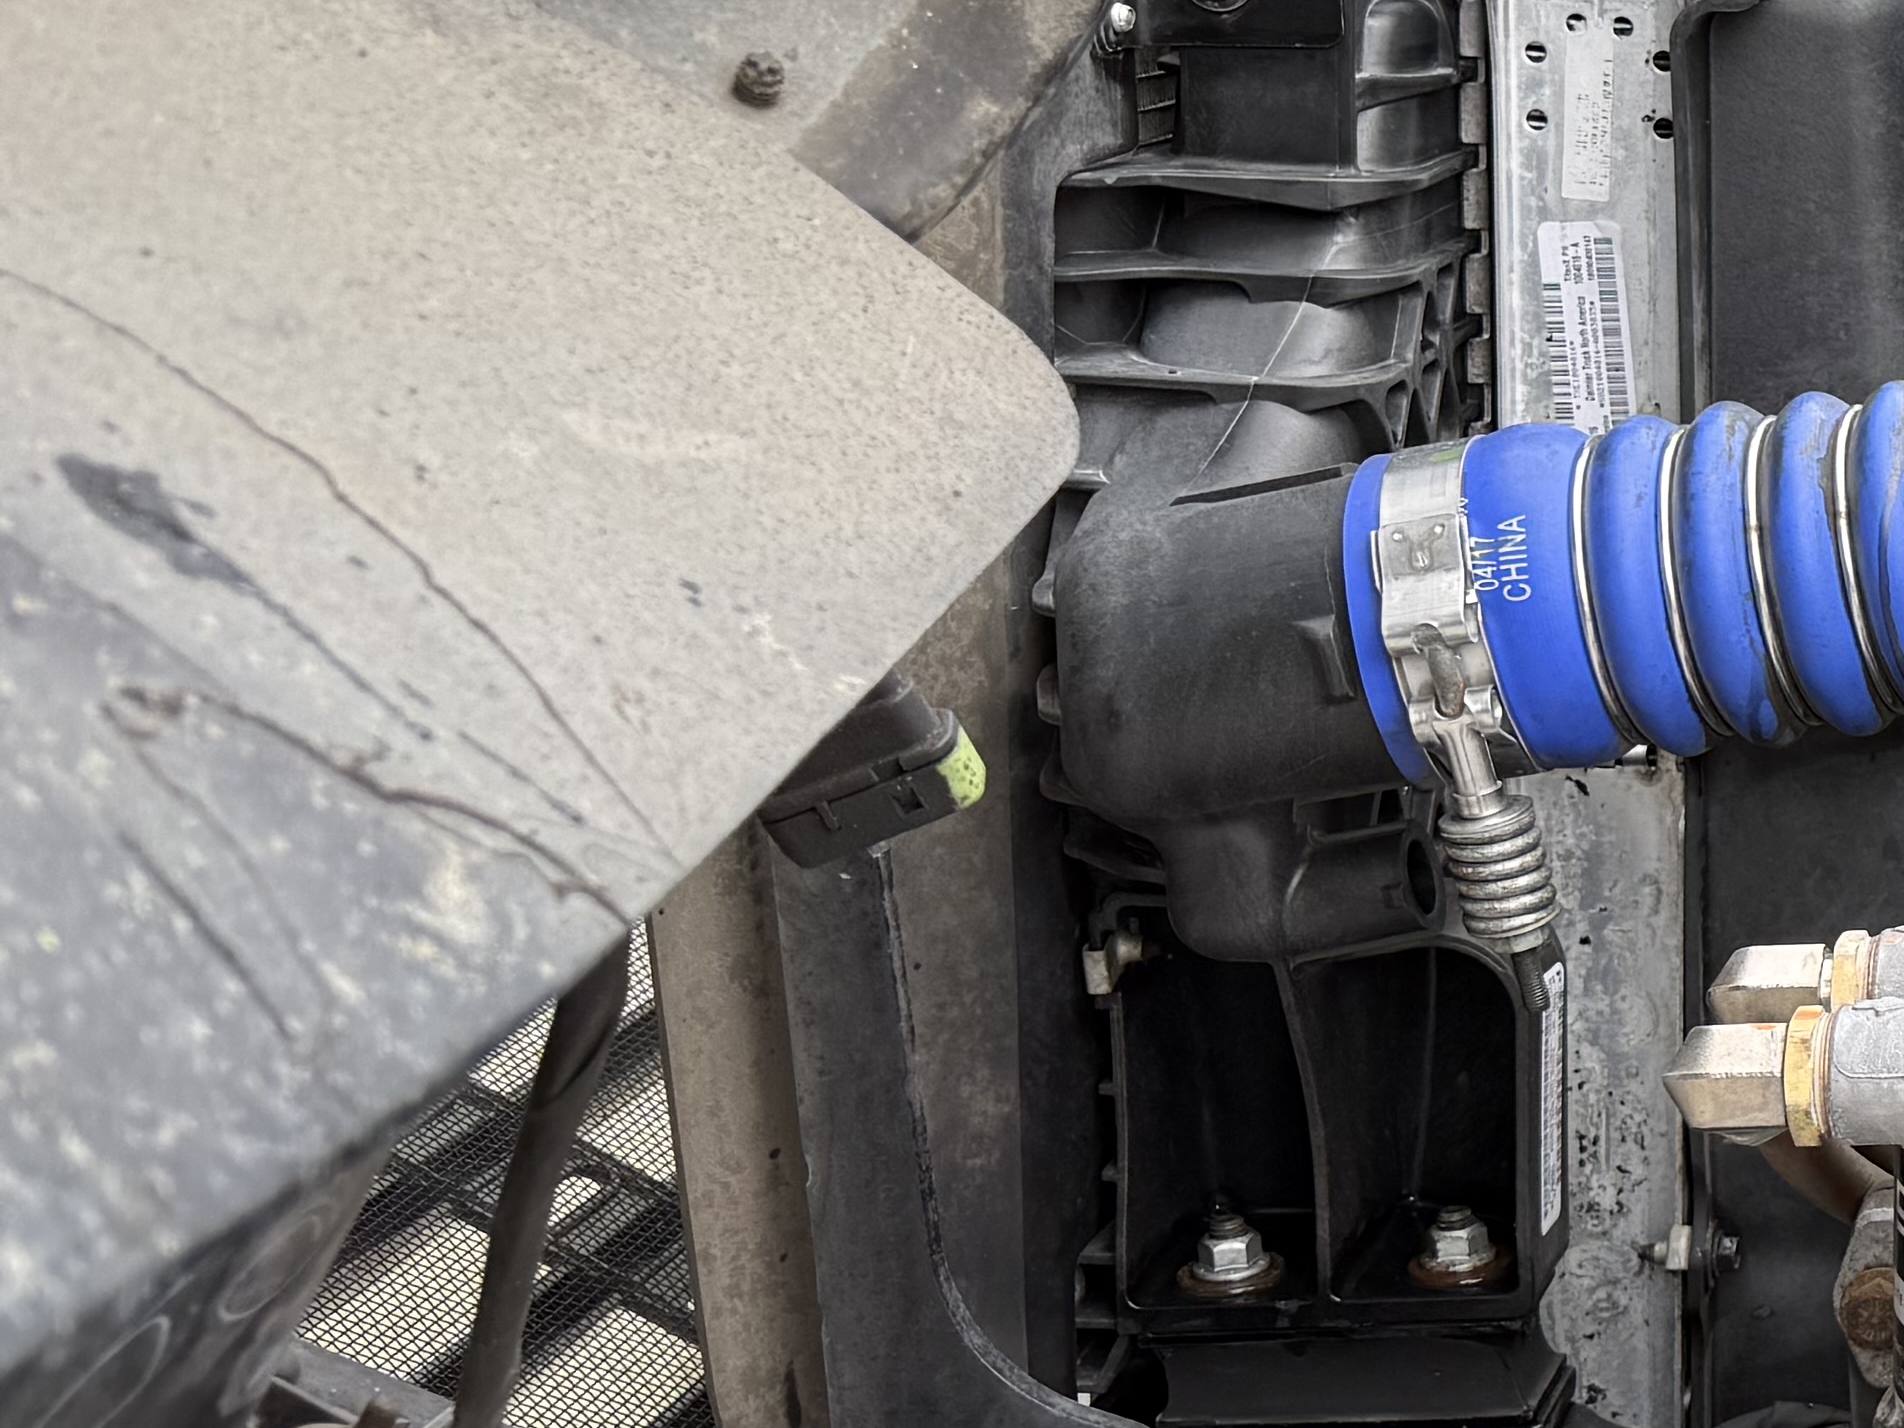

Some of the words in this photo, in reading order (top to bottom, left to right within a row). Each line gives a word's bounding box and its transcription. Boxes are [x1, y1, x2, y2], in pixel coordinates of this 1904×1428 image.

[1576, 296, 1587, 326] America
[1579, 328, 1590, 348] North
[1582, 350, 1592, 370] Truck
[1497, 514, 1532, 603] CHINA
